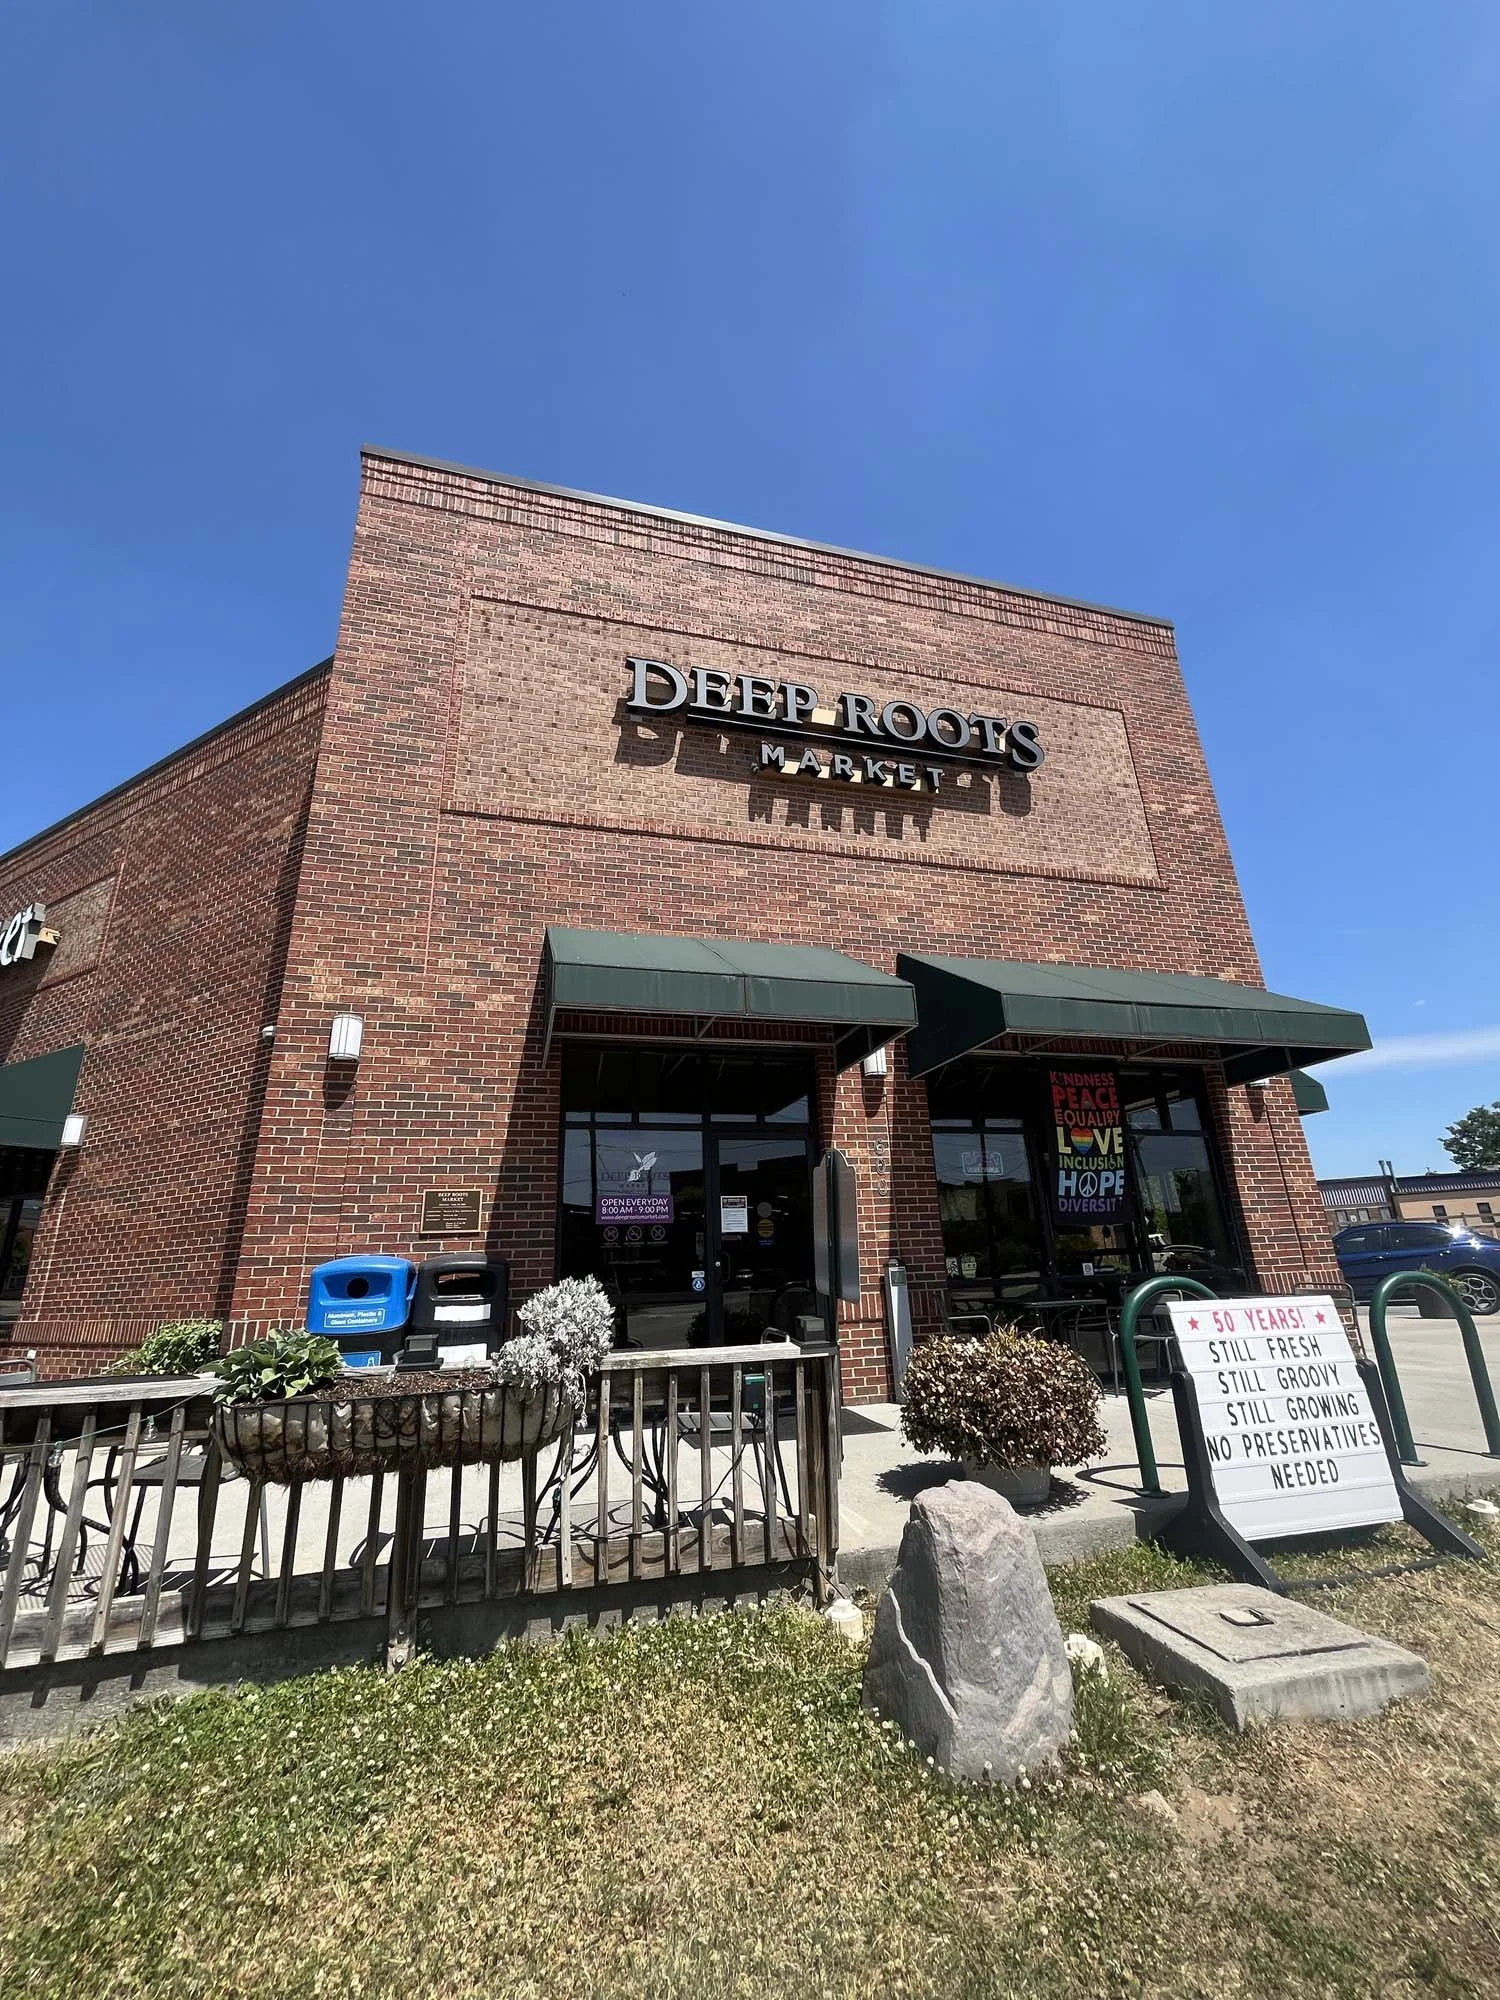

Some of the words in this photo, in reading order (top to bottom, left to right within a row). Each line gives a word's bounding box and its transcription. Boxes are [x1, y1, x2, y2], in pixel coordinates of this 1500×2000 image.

[625, 656, 818, 724] DEEP
[839, 692, 1046, 774] ROOTS
[758, 741, 945, 794] MARKET
[1052, 1085, 1121, 1110] PEACE
[1054, 1108, 1121, 1128] EQUALITY
[1057, 1170, 1125, 1198] HOPE
[601, 1198, 625, 1207] OPEN
[626, 1198, 669, 1206] EVERYDAY
[601, 1206, 619, 1215] 8:00
[619, 1206, 633, 1214] AM
[656, 1206, 669, 1214] PM
[1058, 1197, 1123, 1213] DIVERSIT
[1212, 1310, 1236, 1333] 50
[1245, 1308, 1307, 1332] YEARS!
[1208, 1338, 1257, 1364] STILL
[1267, 1335, 1323, 1360] FRESH
[1217, 1370, 1266, 1395] STILL
[1277, 1363, 1341, 1390] GROOVY
[1227, 1401, 1275, 1427] STILL
[1286, 1393, 1360, 1421] GROWING
[1206, 1435, 1232, 1463] NO
[1242, 1422, 1381, 1459] PRESERVATIVES
[1270, 1458, 1339, 1490] NEEDED
